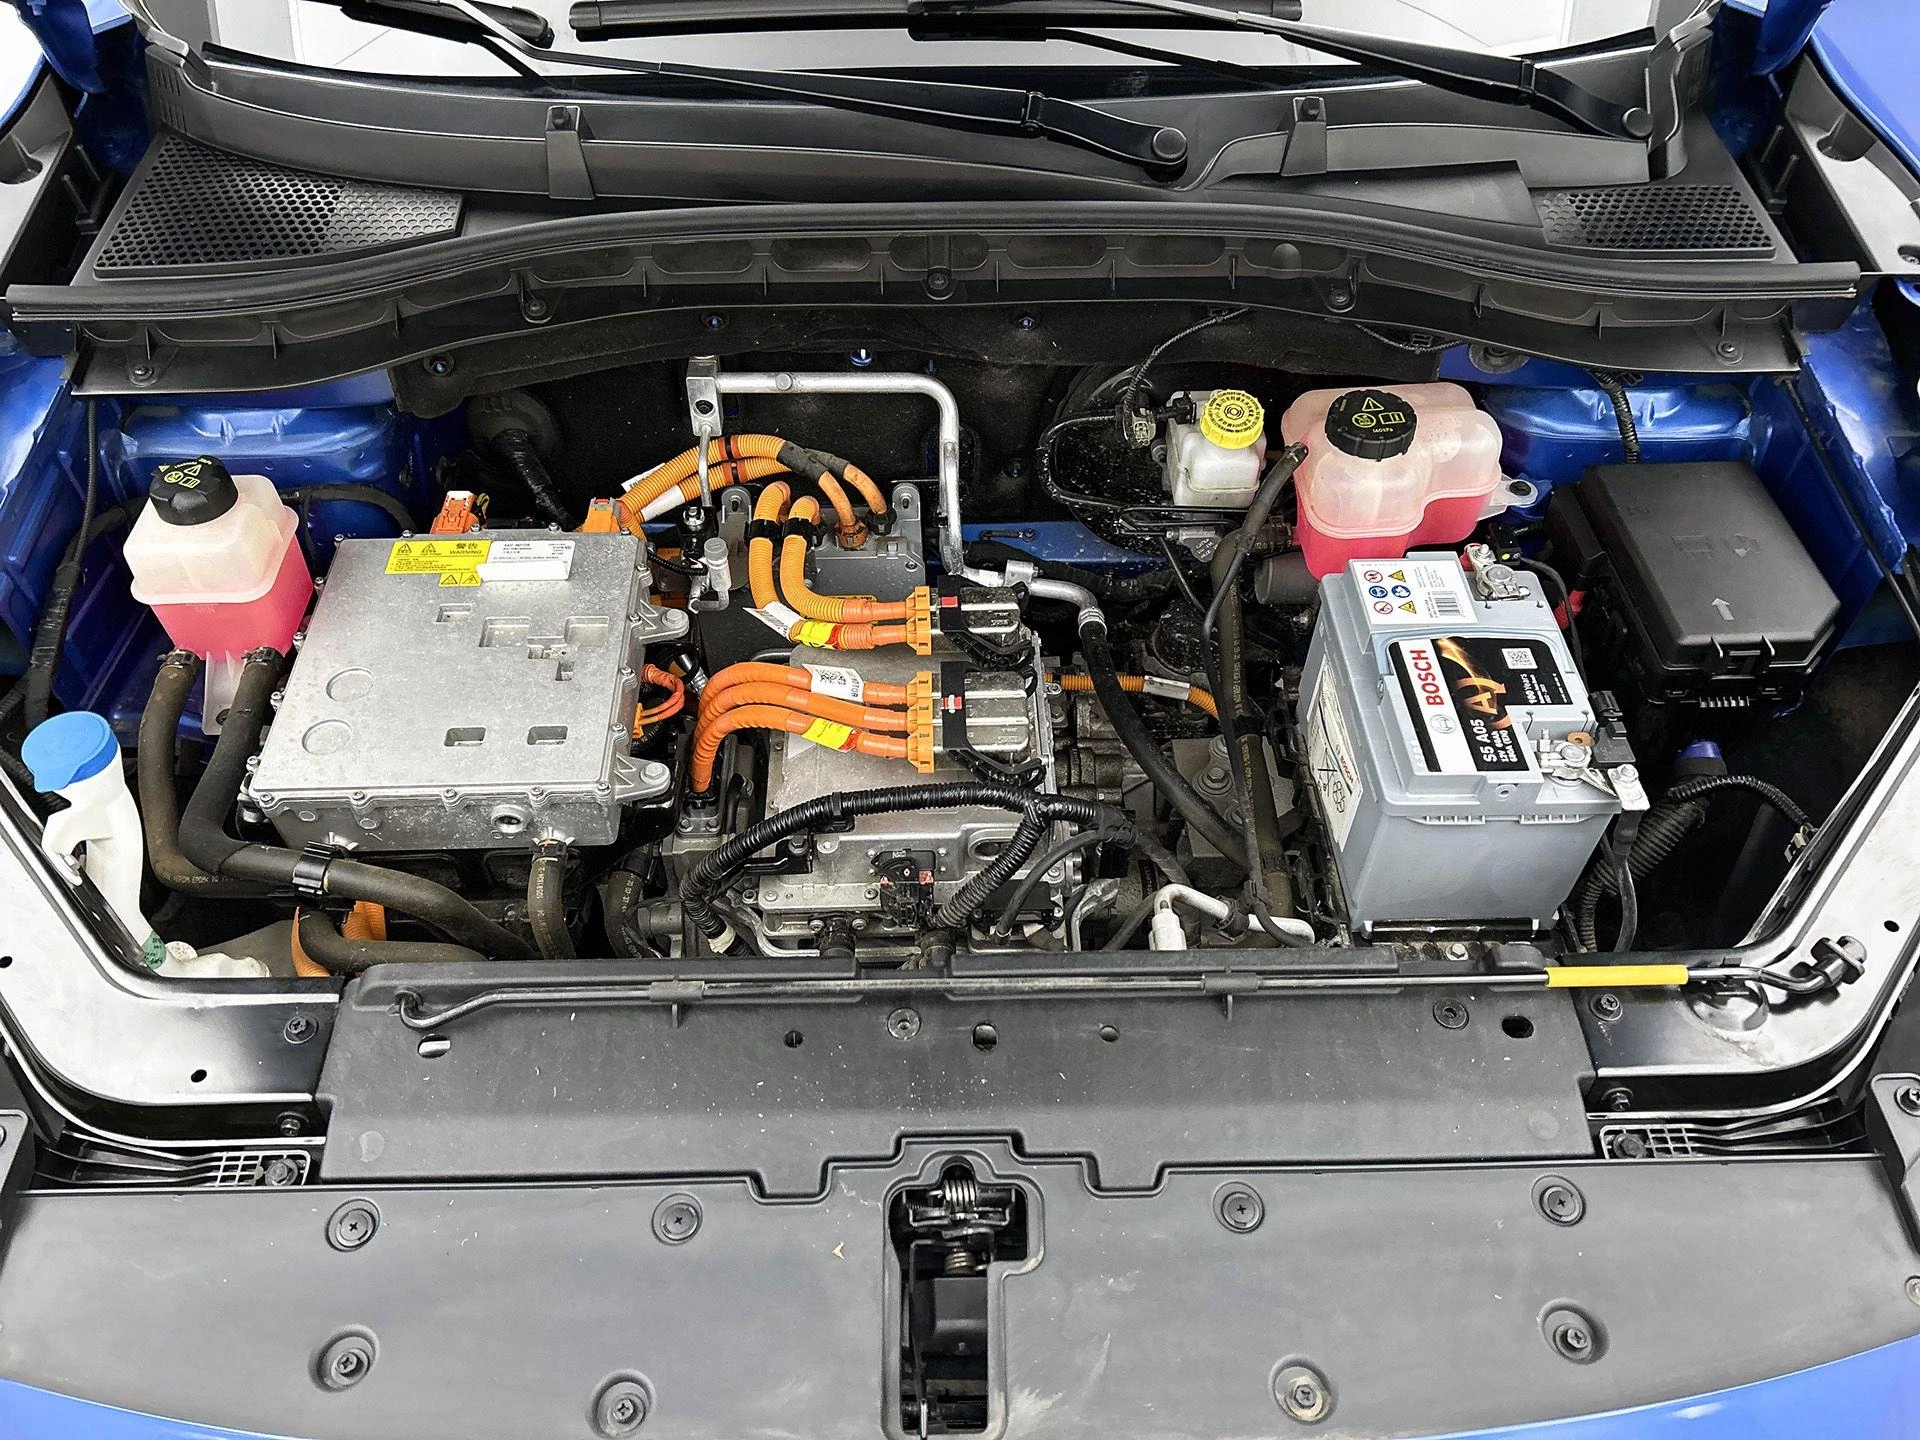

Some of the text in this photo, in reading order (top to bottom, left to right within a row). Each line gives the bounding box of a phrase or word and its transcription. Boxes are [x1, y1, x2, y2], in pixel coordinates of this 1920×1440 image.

[1409, 650, 1445, 705] BOSCH
[1470, 719, 1498, 763] S5 A05
